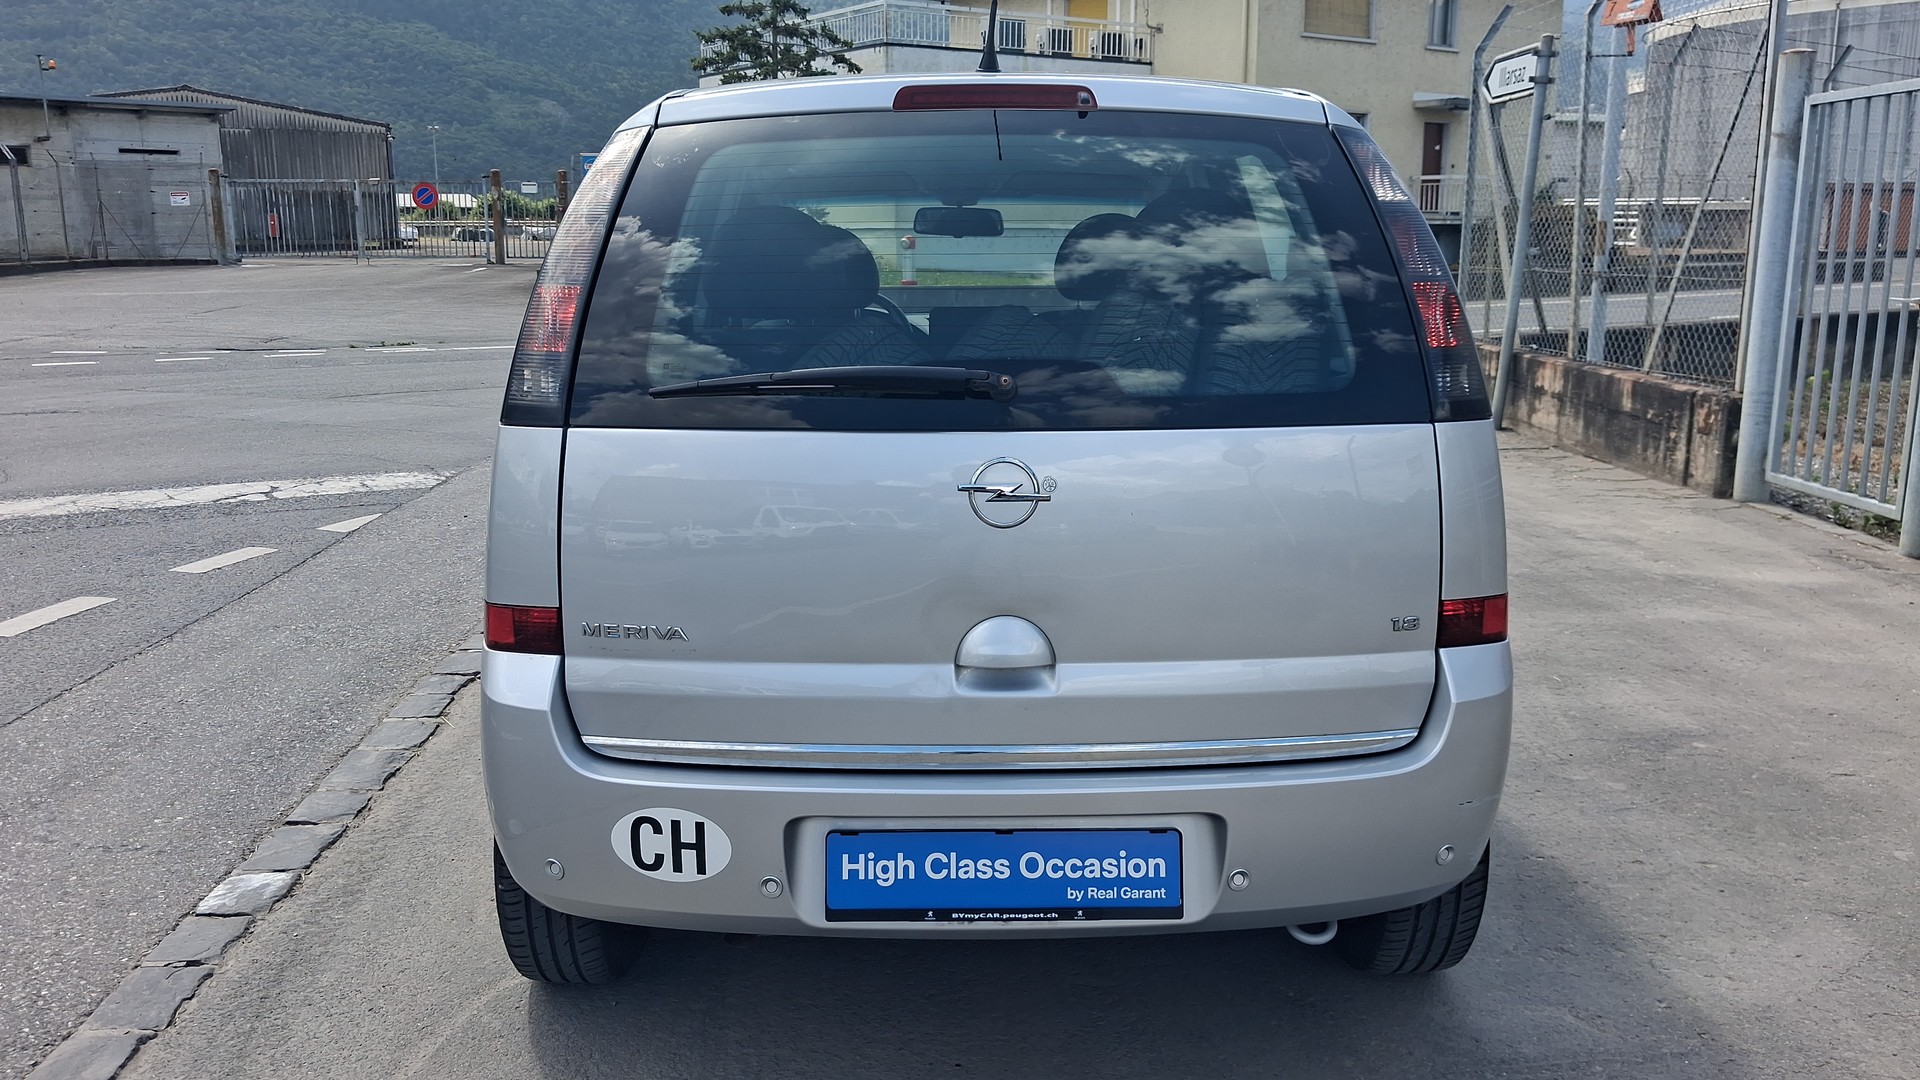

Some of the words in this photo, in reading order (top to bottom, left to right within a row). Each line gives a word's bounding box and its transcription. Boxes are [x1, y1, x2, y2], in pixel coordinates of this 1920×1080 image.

[581, 622, 690, 642] MERIVA
[630, 815, 708, 875] CH
[841, 853, 915, 887] High
[924, 850, 1011, 881] Class
[1019, 850, 1166, 880] Occasion
[1067, 887, 1085, 903] by
[1088, 887, 1118, 899] Real
[1121, 887, 1166, 899] Garant
